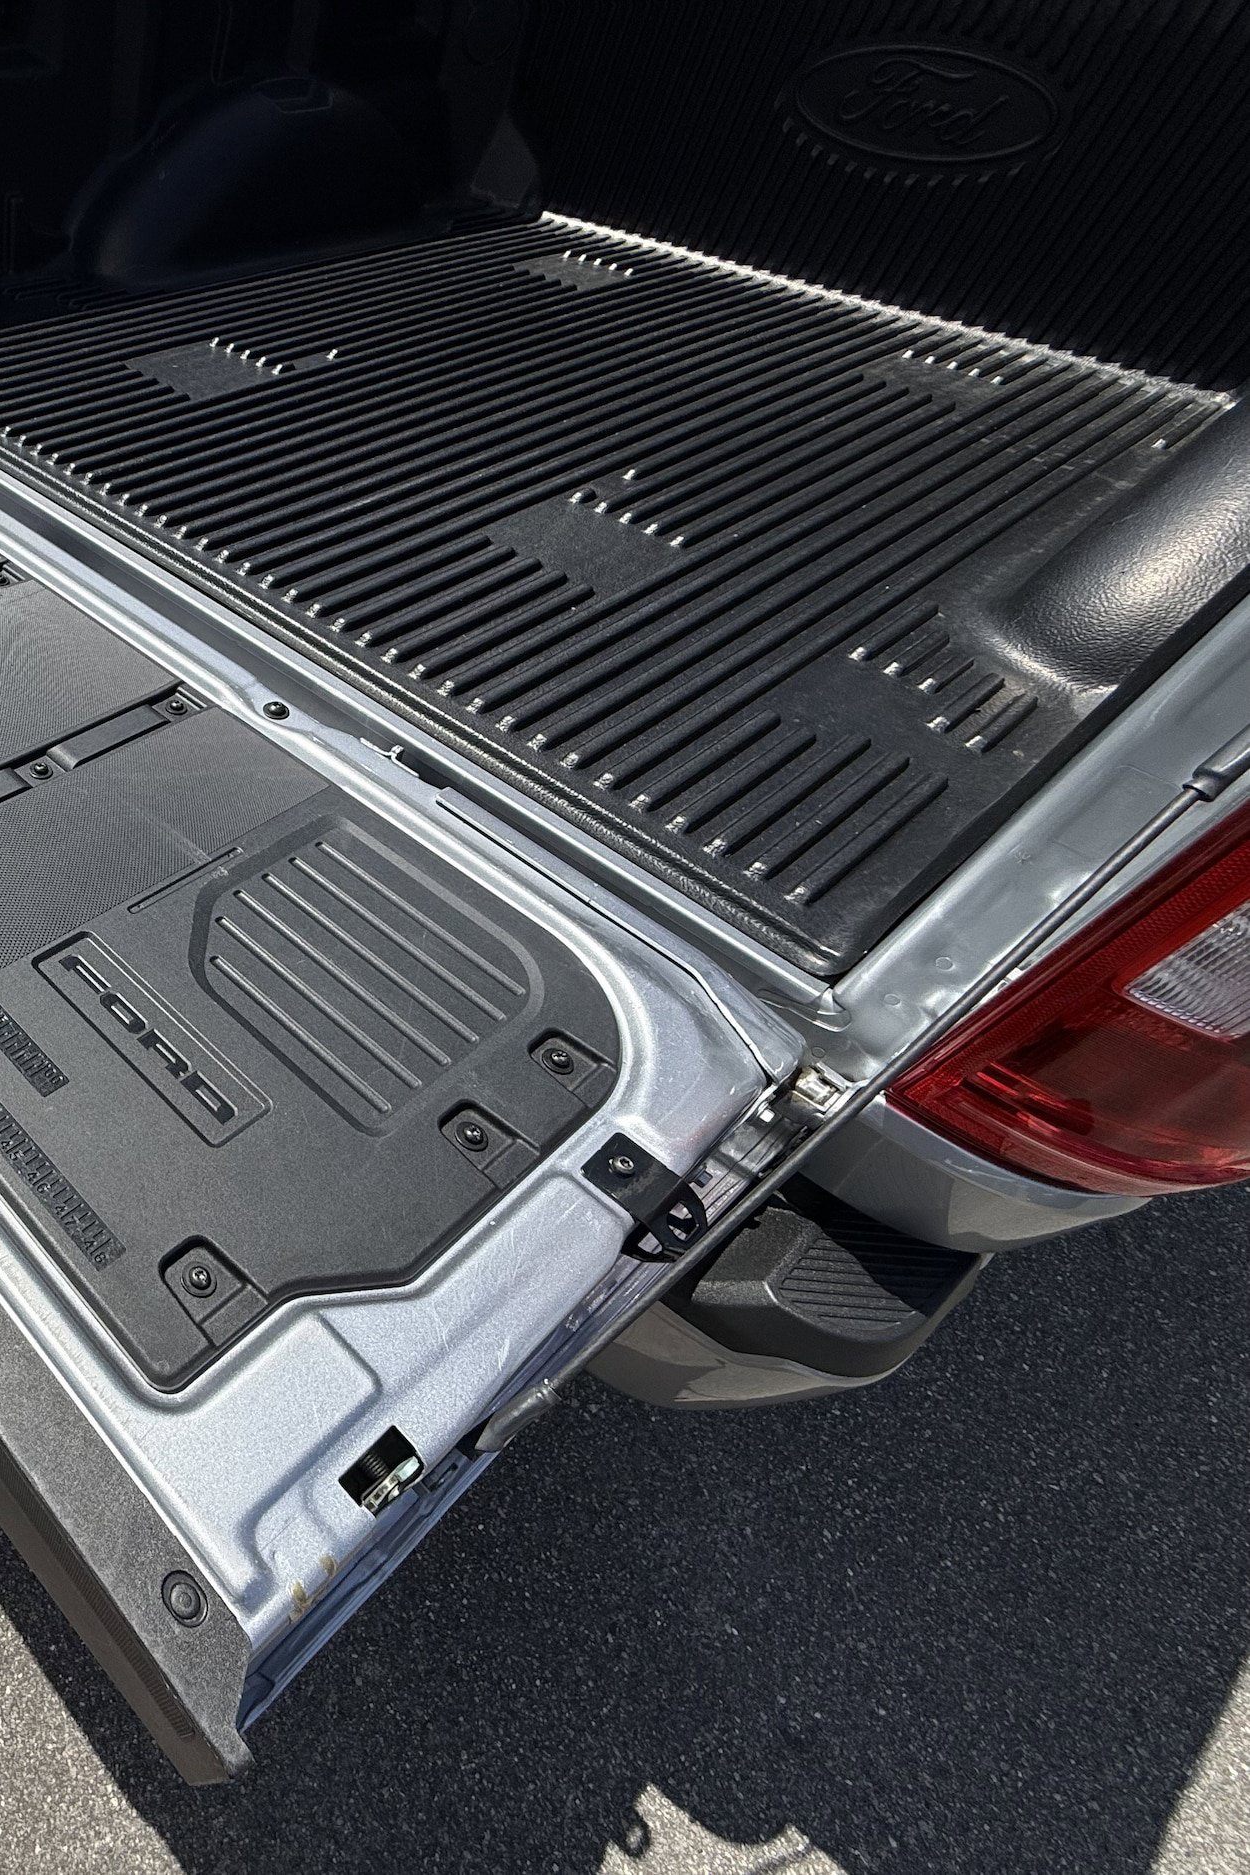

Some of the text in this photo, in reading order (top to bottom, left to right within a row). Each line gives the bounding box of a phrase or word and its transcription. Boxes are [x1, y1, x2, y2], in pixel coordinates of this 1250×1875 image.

[842, 57, 1009, 146] Ford
[34, 1058, 63, 1084] 100
[57, 954, 238, 1126] FORD
[24, 1169, 51, 1193] 46
[52, 1202, 79, 1227] 47
[81, 1238, 108, 1263] 48
